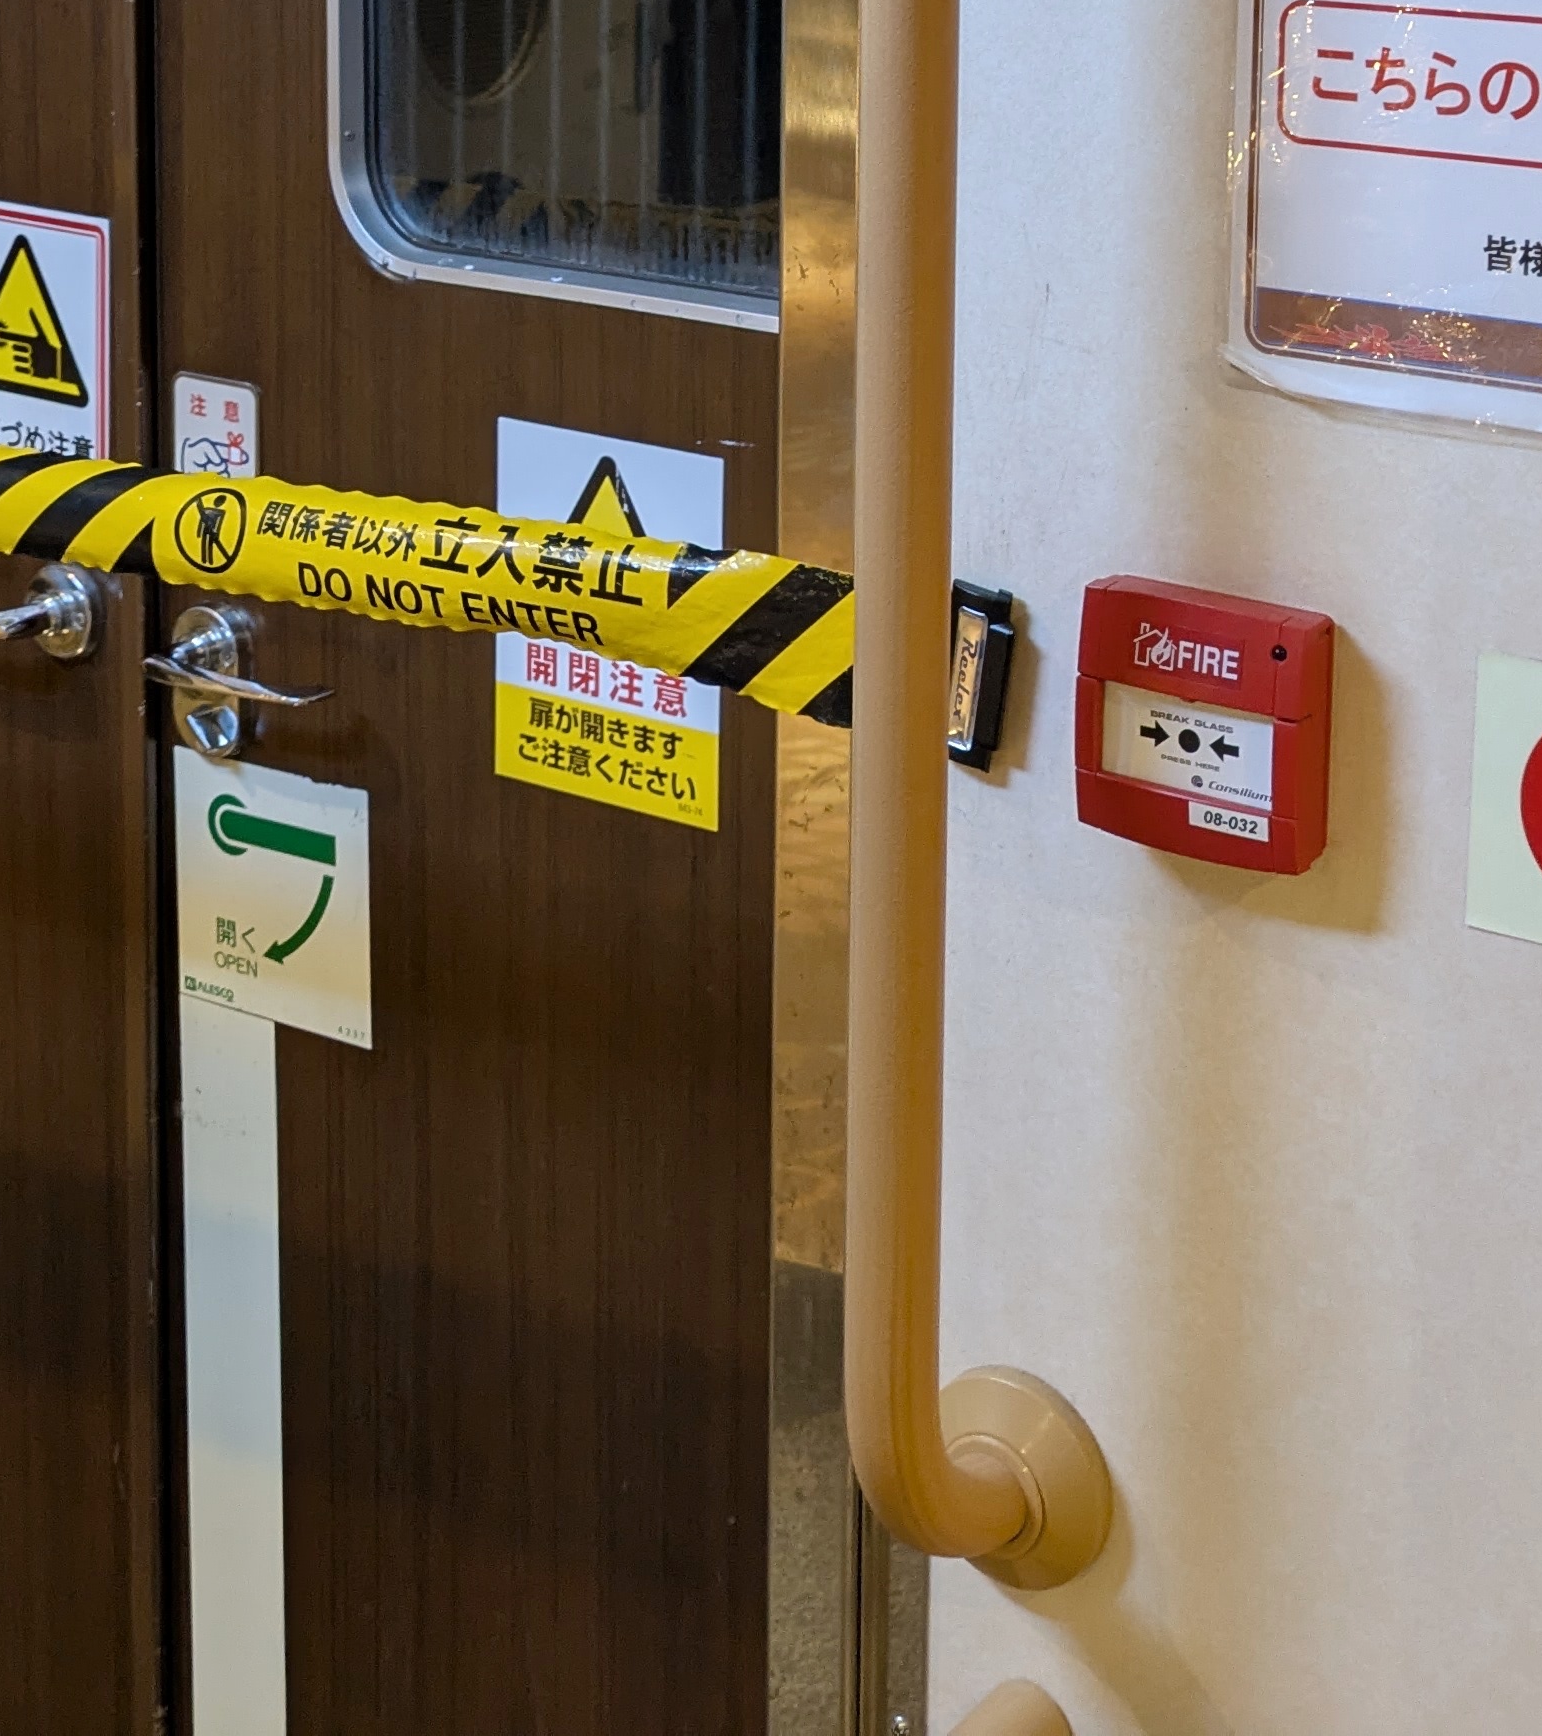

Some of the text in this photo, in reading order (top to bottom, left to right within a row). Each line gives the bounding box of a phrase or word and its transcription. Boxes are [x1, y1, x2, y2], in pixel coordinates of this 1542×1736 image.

[256, 500, 644, 608] 関係者以外立入禁止
[298, 561, 605, 647] DO NOT ENTER
[526, 641, 689, 719] 開閉注意
[952, 636, 980, 721] Reelex
[1176, 640, 1240, 681] FIRE
[527, 696, 684, 760] 扉が開きます
[1150, 710, 1234, 734] BREAK GLASS
[517, 733, 697, 801] ご注意ください
[1160, 754, 1221, 773] PRESS HERE
[1203, 810, 1259, 835] 08-032
[215, 916, 257, 955] 開く
[213, 950, 259, 978] OPEN
